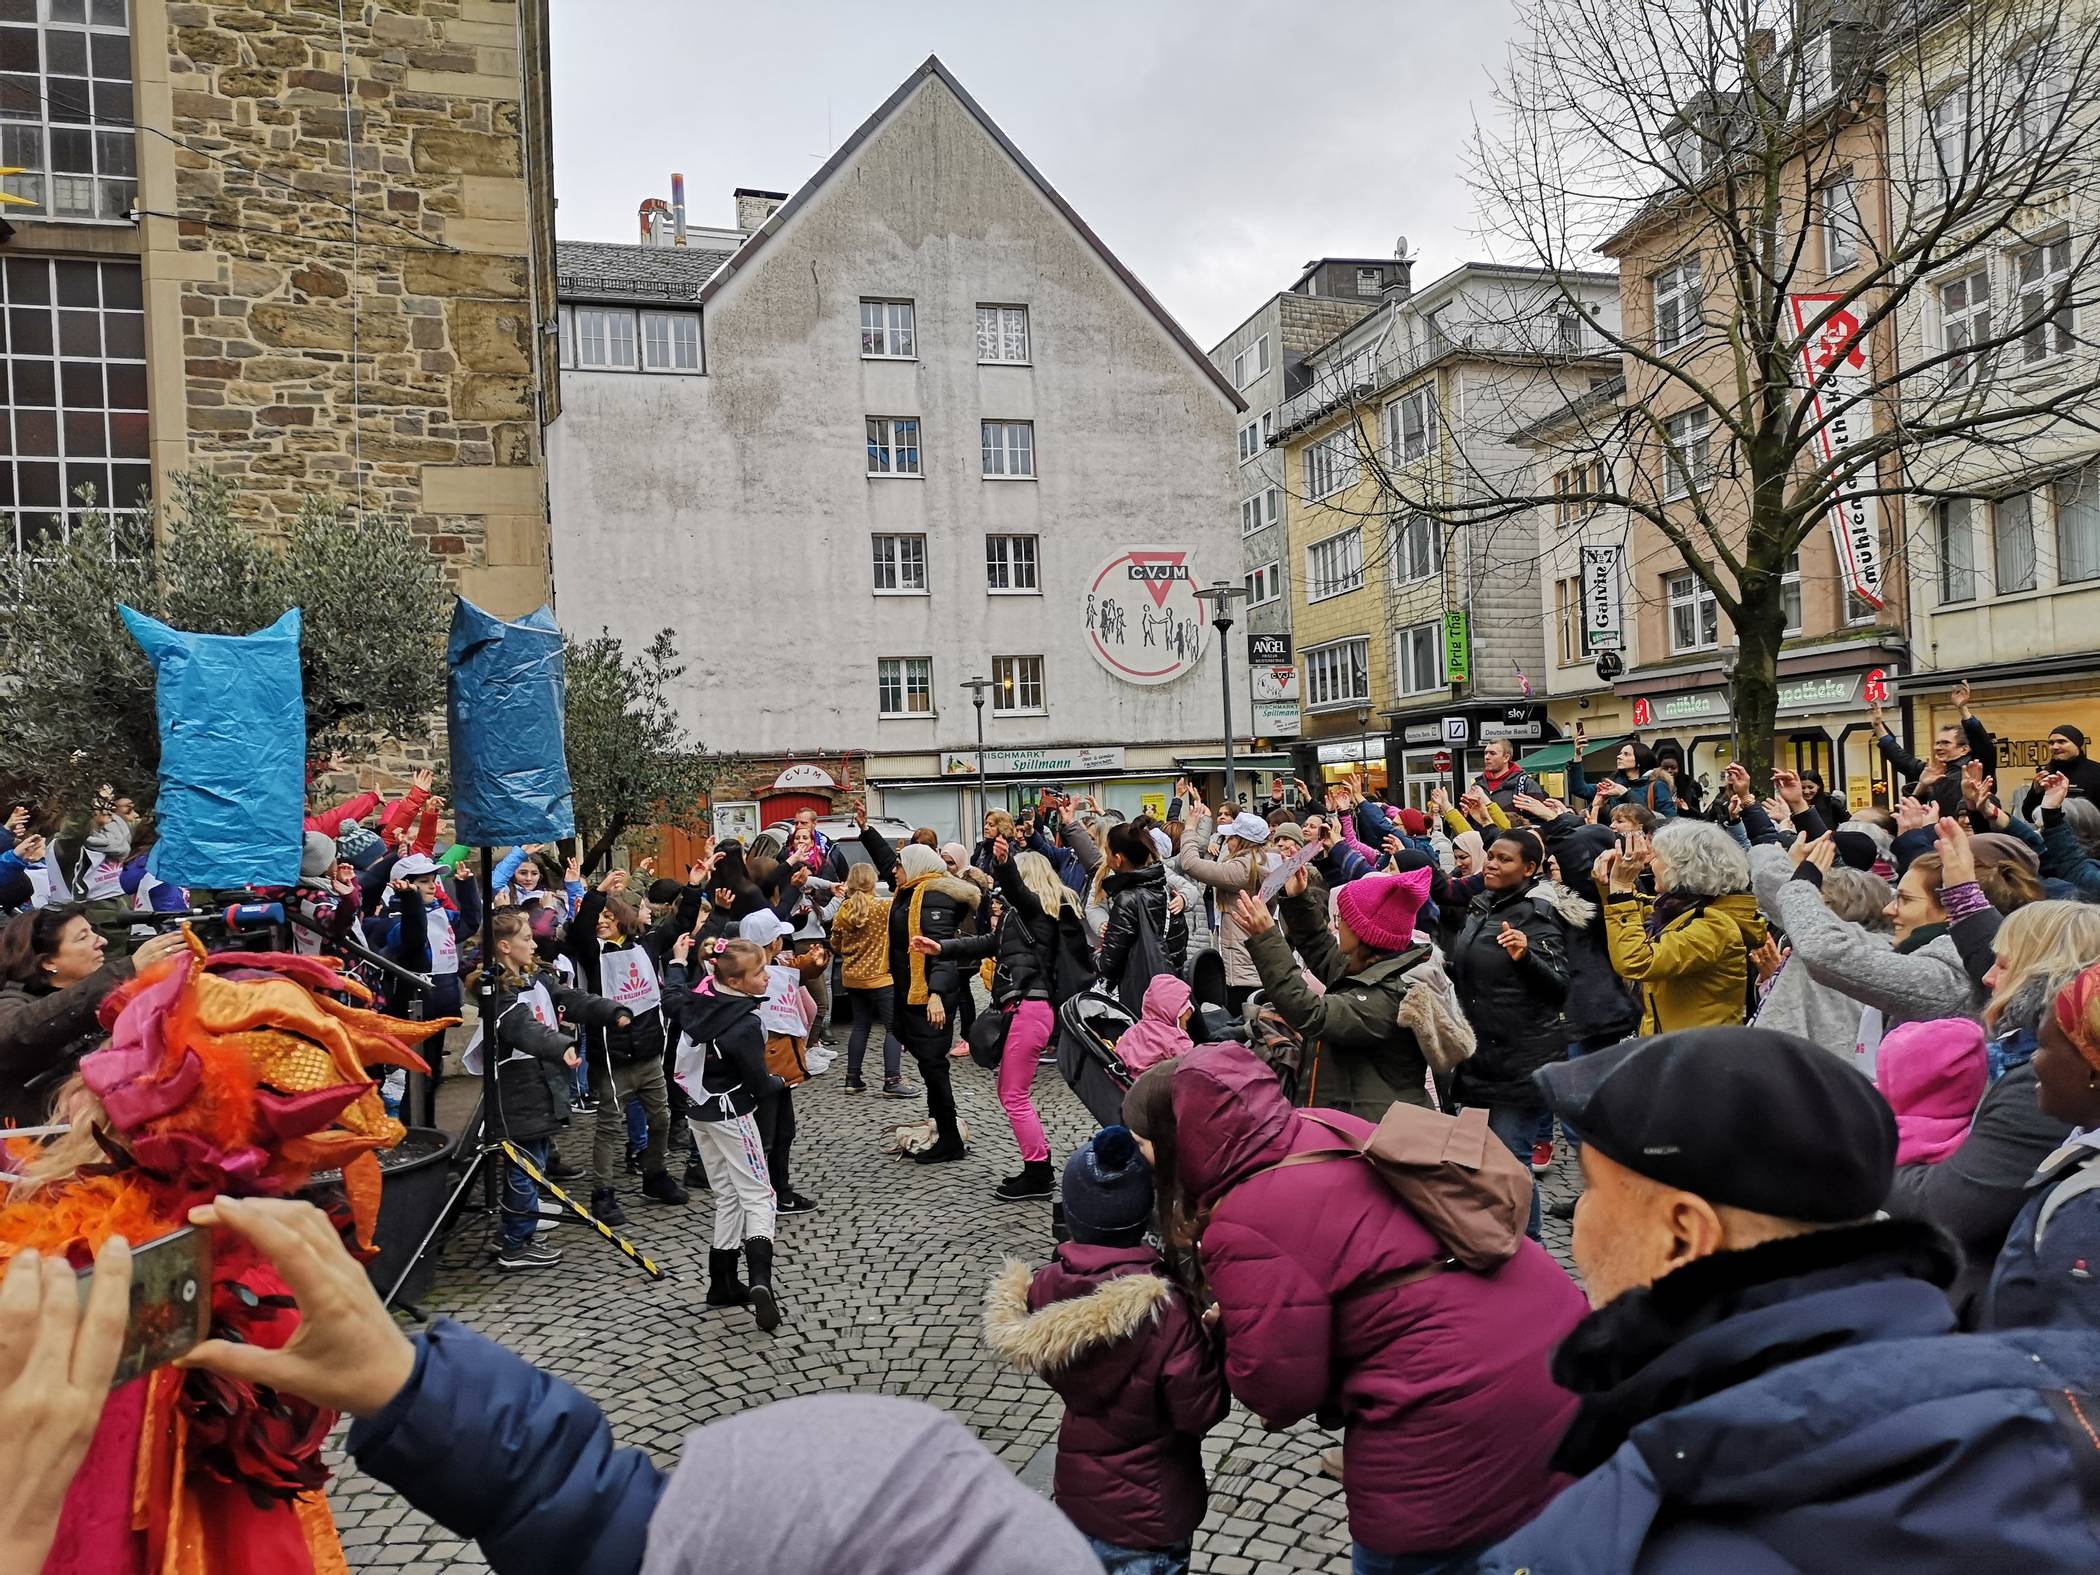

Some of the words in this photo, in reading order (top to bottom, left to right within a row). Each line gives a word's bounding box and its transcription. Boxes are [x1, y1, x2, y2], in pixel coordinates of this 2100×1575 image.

[1131, 567, 1186, 579] CVJM
[1253, 640, 1287, 653] ANGEL
[1665, 696, 1711, 716] mühlen
[1508, 708, 1525, 720] sky
[975, 751, 1046, 760] FRISCHMARKT
[1012, 759, 1071, 772] Spillmann
[785, 768, 822, 781] CVJM
